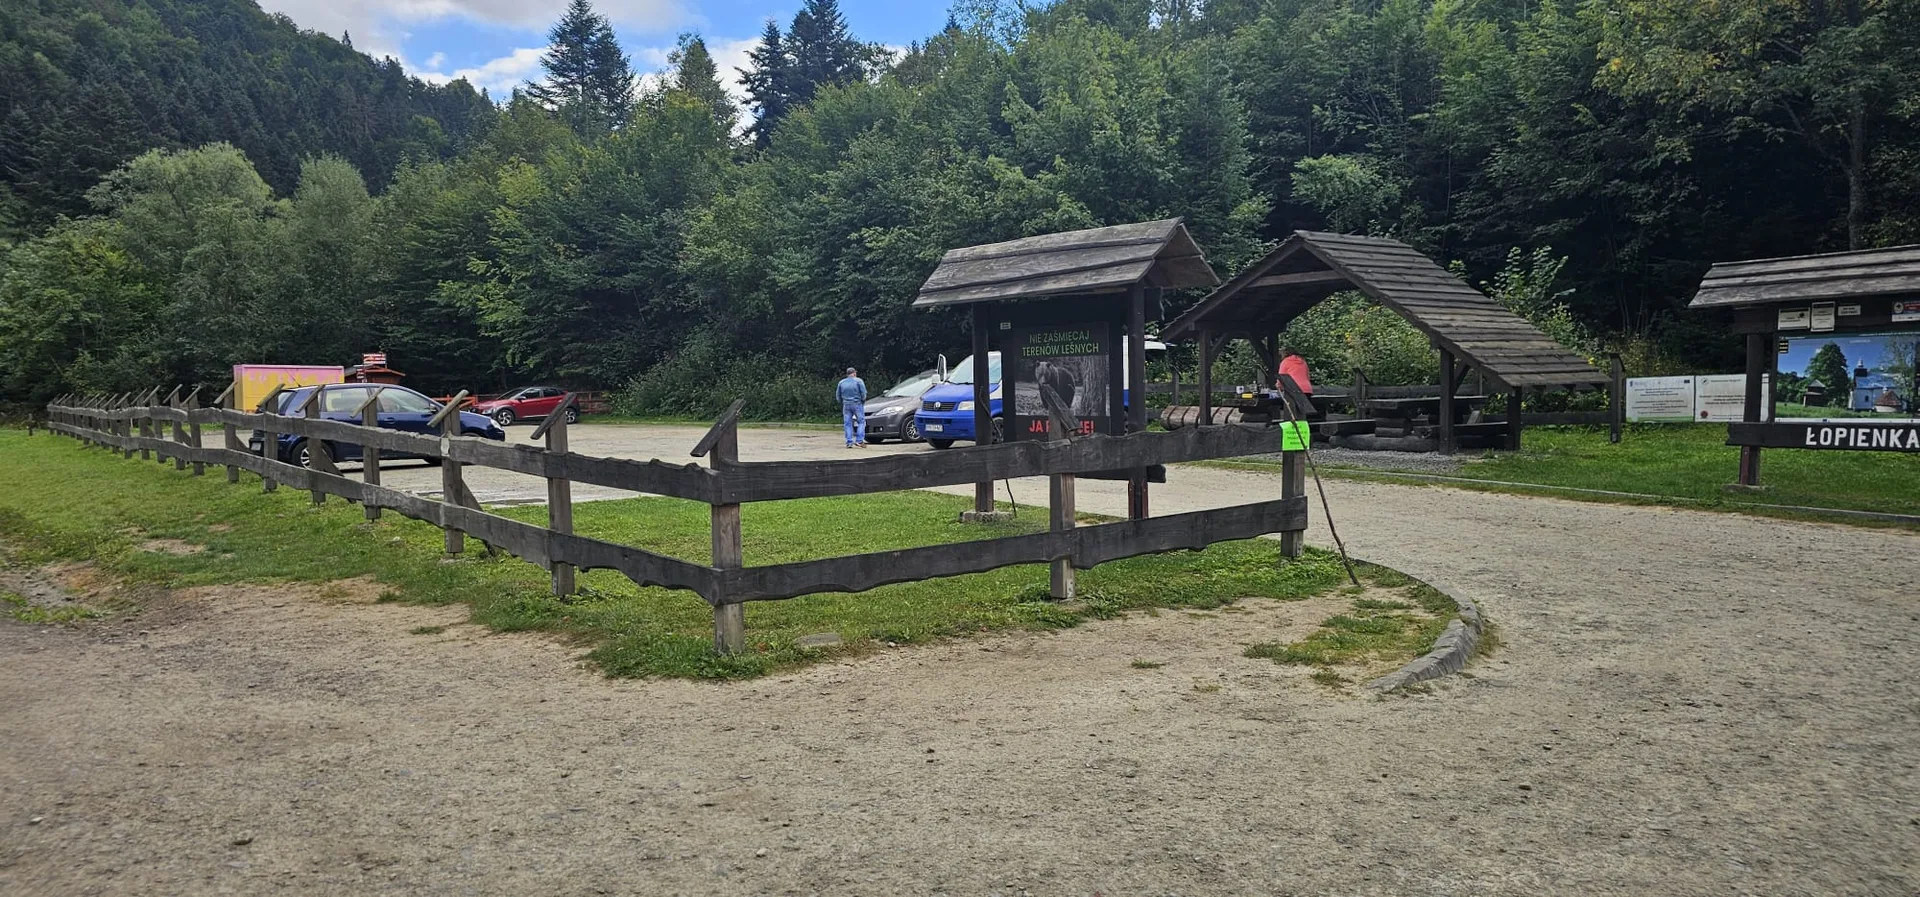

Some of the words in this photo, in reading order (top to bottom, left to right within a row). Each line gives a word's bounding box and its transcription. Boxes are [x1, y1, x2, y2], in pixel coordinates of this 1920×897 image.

[1029, 333, 1042, 344] NIE
[1043, 329, 1090, 343] ZAŚMIECAJ
[1022, 342, 1060, 357] TERENÓW
[1061, 341, 1099, 354] LEŚNYCH
[1028, 420, 1044, 433] JA
[1805, 427, 1920, 449] ŁOPIENKA
